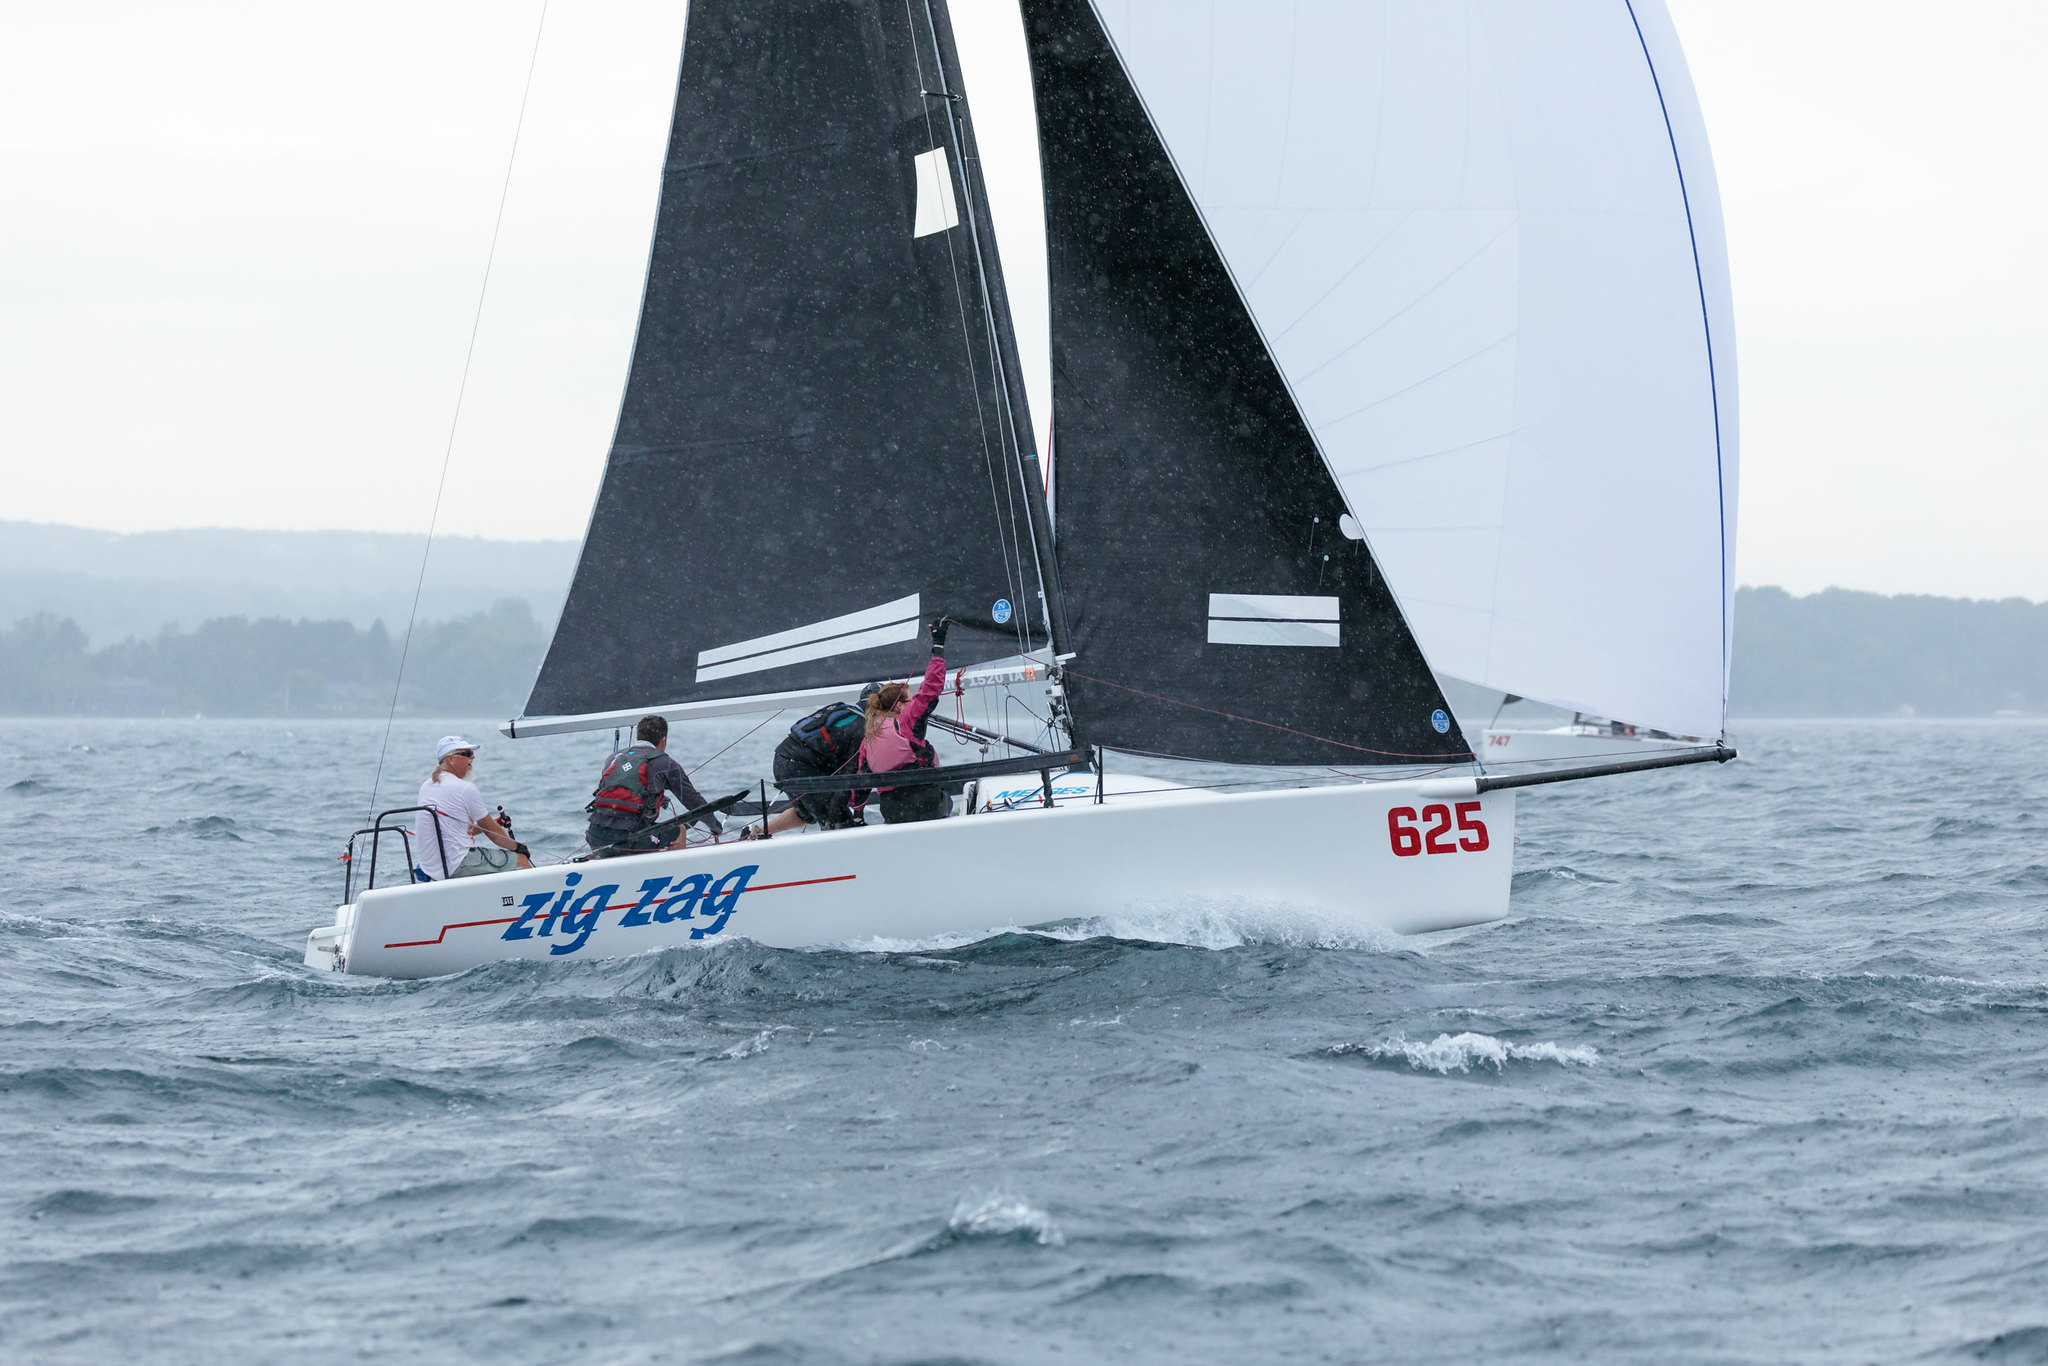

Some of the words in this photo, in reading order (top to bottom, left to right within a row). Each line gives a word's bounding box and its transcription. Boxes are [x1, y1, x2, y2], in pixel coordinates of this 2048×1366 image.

[969, 673, 1003, 687] 1520
[1488, 735, 1511, 747] 747
[1387, 801, 1490, 857] 625
[500, 871, 620, 956] zig
[617, 864, 760, 940] zag
